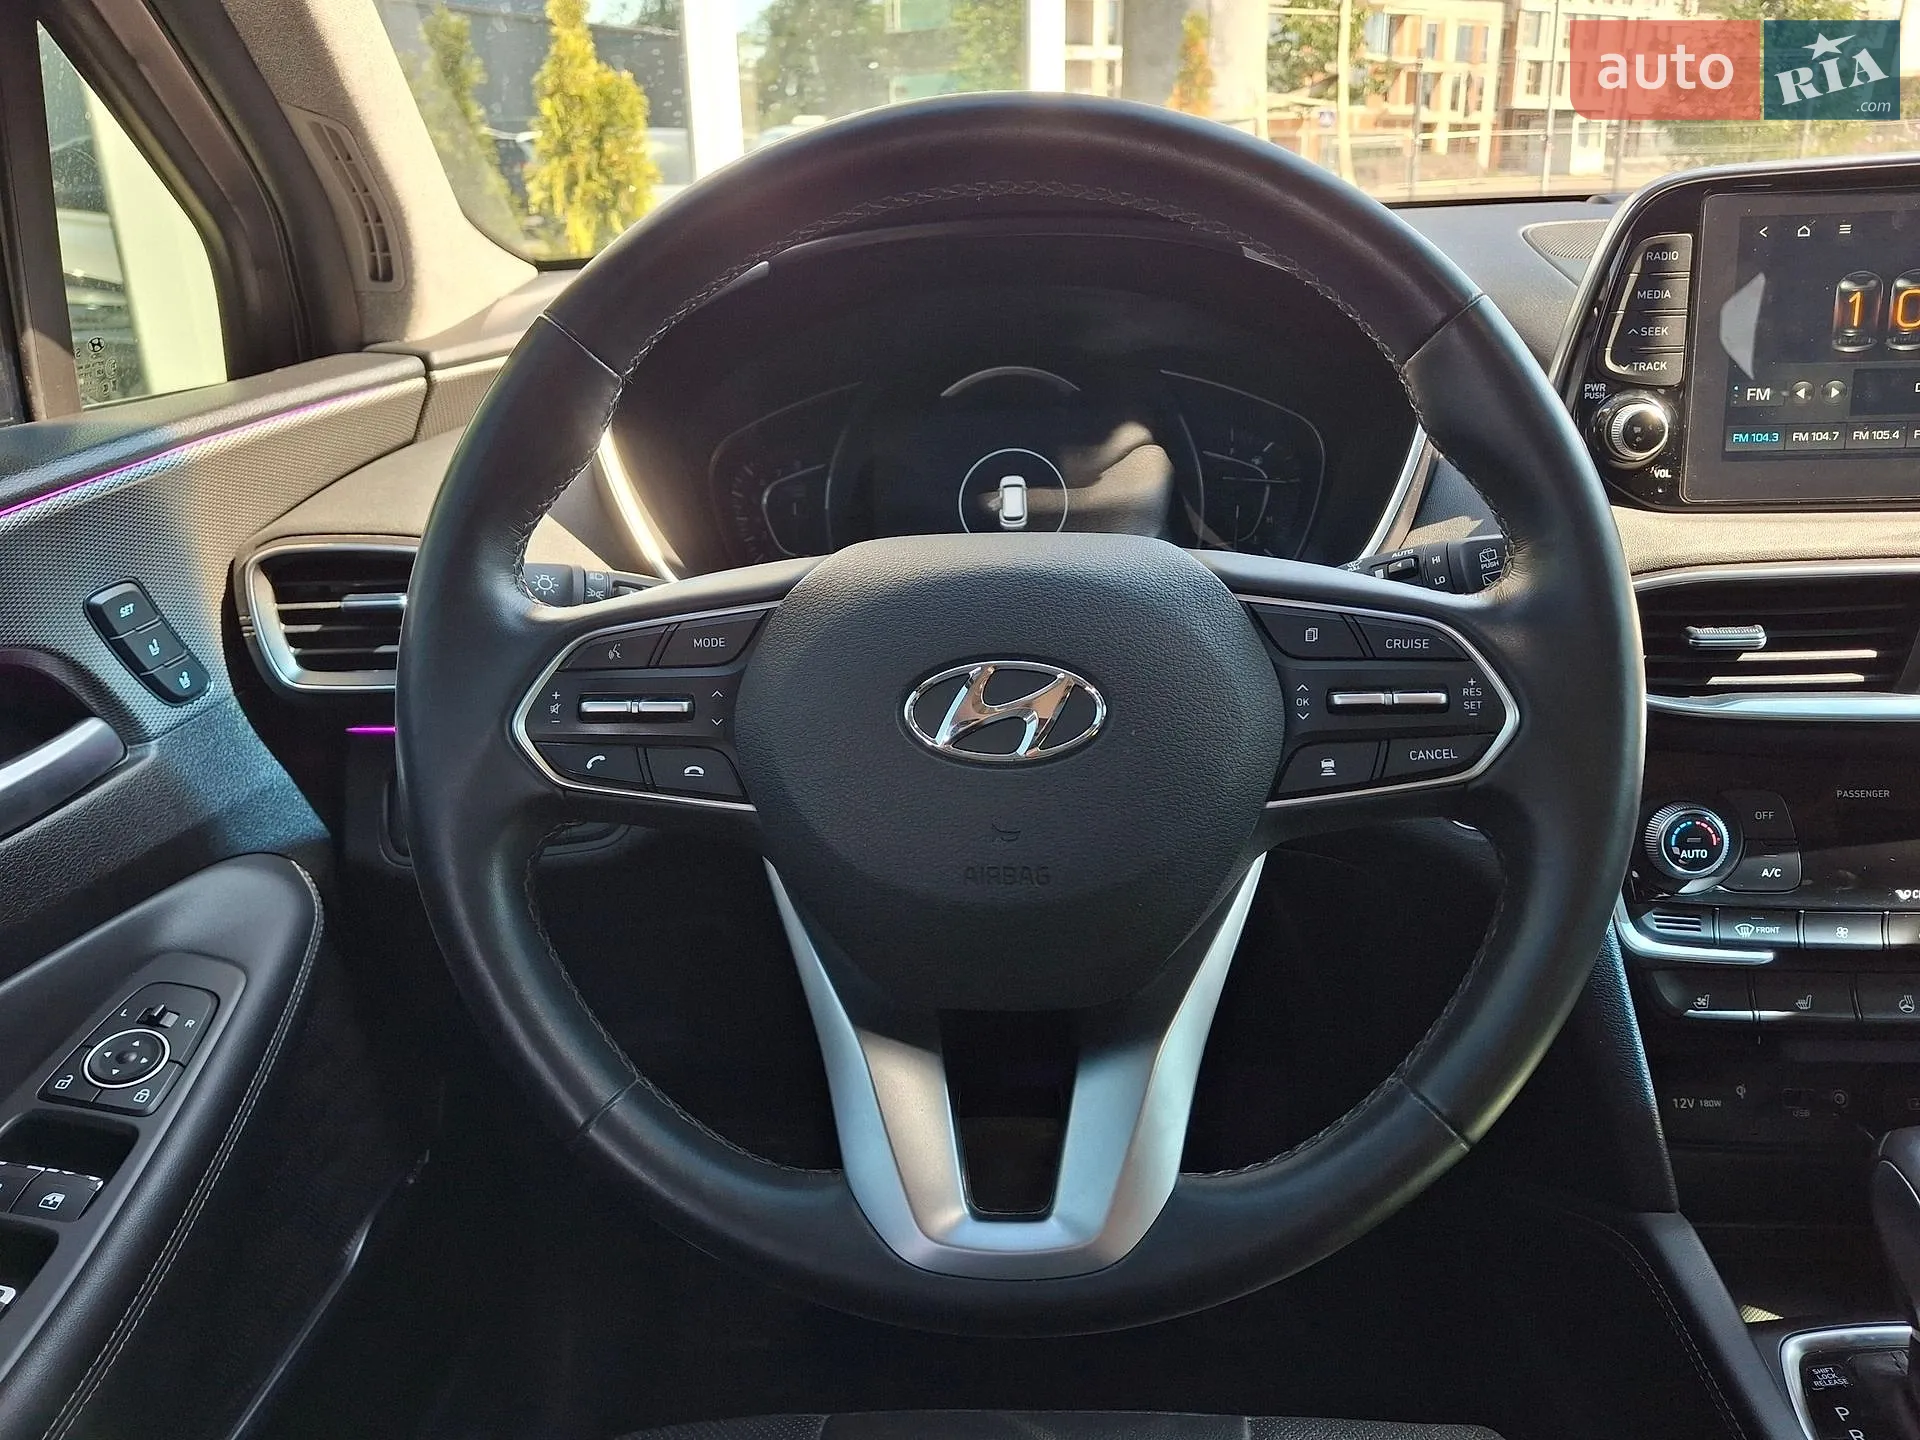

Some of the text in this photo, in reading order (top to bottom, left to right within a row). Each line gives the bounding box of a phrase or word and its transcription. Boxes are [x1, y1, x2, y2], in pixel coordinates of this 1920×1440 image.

[1646, 251, 1679, 261] RADIO
[1637, 289, 1671, 300] MEDIA
[1641, 326, 1669, 336] SEEK
[1632, 361, 1667, 371] TRACK
[1584, 383, 1606, 392] PWR
[1584, 391, 1605, 400] PUSH
[1746, 388, 1771, 400] FM
[1732, 432, 1779, 443] FM 104.3
[1792, 431, 1839, 442] FM 104.7
[1853, 430, 1900, 441] FM 105.4
[1653, 469, 1672, 479] VOL
[1391, 549, 1414, 558] AUTO
[1431, 555, 1441, 564] HI
[1480, 561, 1500, 570] PUSH
[1434, 576, 1446, 585] LO
[119, 603, 135, 618] SET
[693, 638, 726, 648] MODE
[1385, 638, 1430, 649] CRUISE
[1462, 687, 1482, 697] RES
[1296, 697, 1310, 707] OK
[1463, 701, 1481, 710] SET
[1409, 749, 1458, 761] CANCEL
[1836, 789, 1890, 799] PASSENGER
[1755, 810, 1775, 821] OFF
[1680, 848, 1708, 860] AUTO
[964, 866, 1050, 886] AIRBAG
[1761, 867, 1782, 879] A/C
[1756, 926, 1780, 936] FRONT
[184, 1019, 195, 1028] R
[1672, 1098, 1695, 1110] 12V
[1812, 1367, 1834, 1375] SHIFT
[1813, 1379, 1849, 1387] RELEASE
[1834, 1407, 1850, 1422] P
